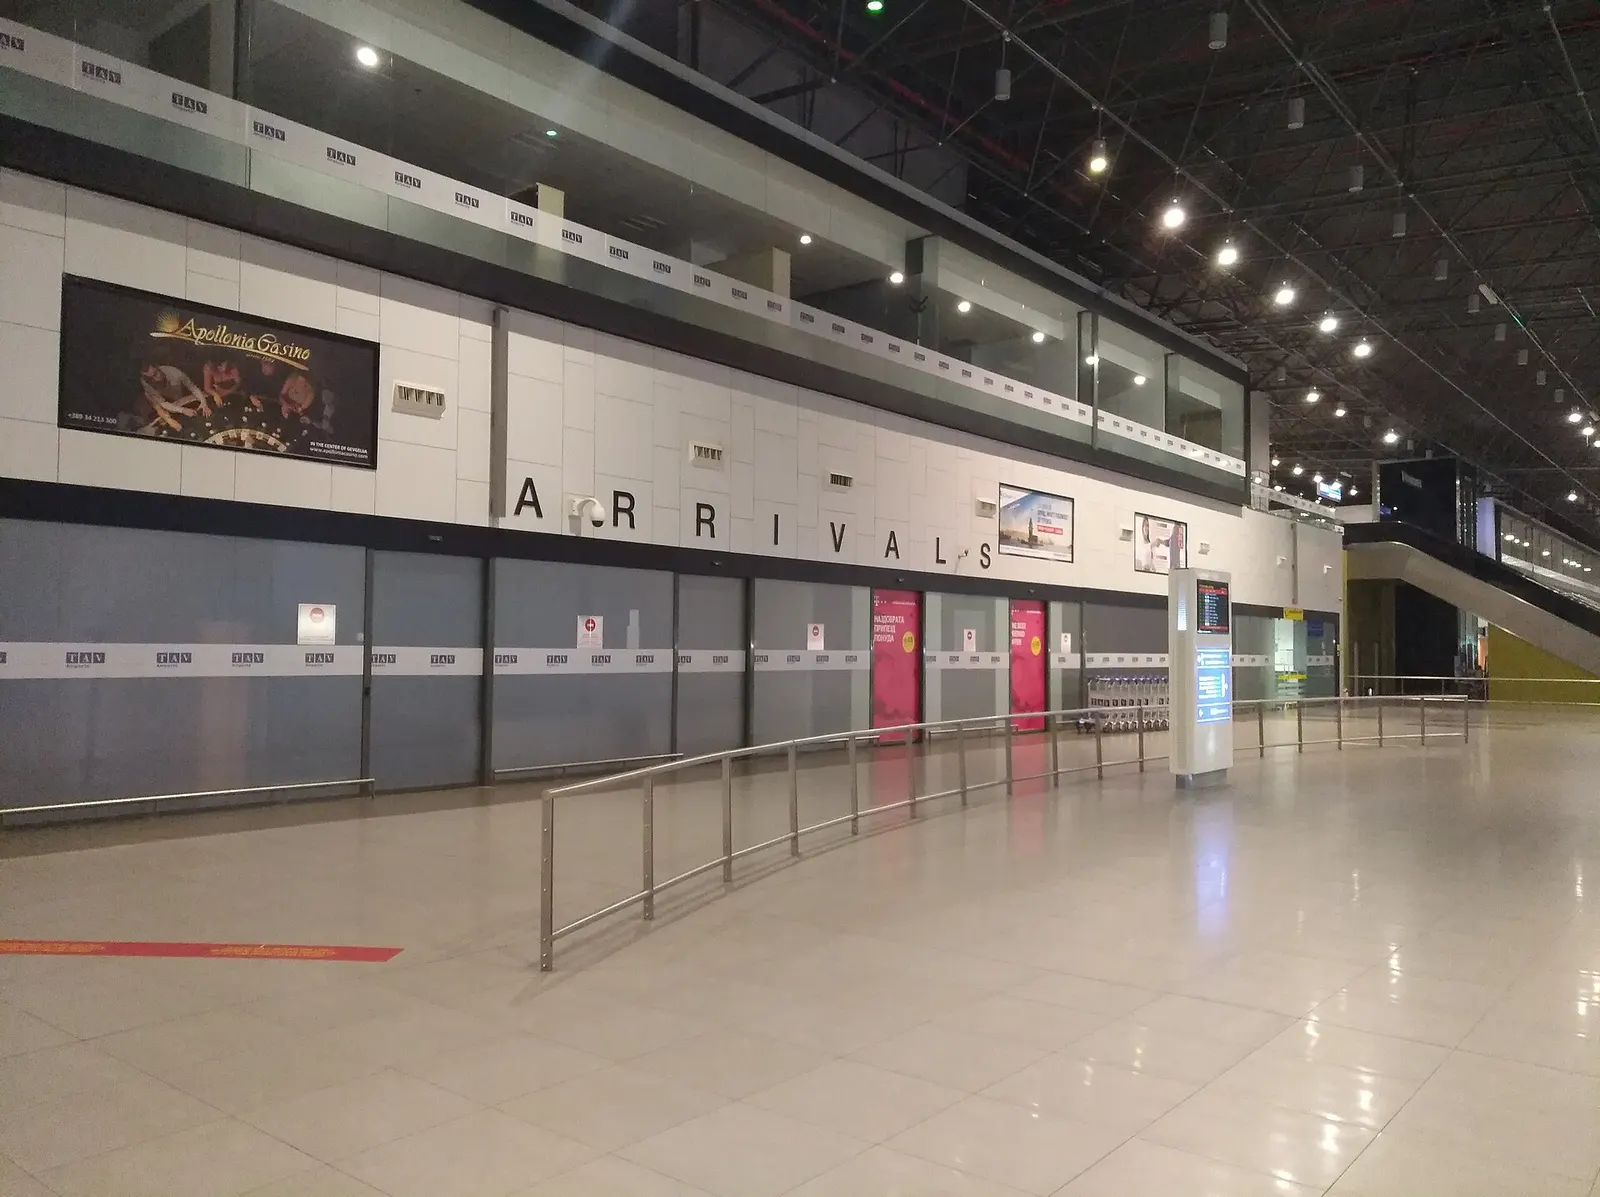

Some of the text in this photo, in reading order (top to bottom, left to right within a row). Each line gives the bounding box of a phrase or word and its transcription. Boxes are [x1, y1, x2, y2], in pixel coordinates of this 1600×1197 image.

[0, 33, 24, 51] AV
[82, 60, 121, 84] TAV
[172, 93, 207, 114] TAV
[254, 121, 285, 141] TAV
[327, 147, 356, 166] TAV
[395, 172, 421, 189] TAV
[455, 193, 479, 208] TAV
[511, 212, 533, 227] TAV
[562, 229, 582, 243] TAV
[610, 246, 629, 260] TAV
[177, 318, 310, 360] Apollonia Casino
[513, 477, 991, 569] ARRIVALS
[66, 652, 105, 663] TAV
[157, 653, 191, 663] TAV
[232, 653, 264, 663] TAV
[305, 653, 334, 663] TAV
[372, 654, 396, 663] TAV
[431, 655, 455, 664] TAV
[495, 655, 517, 663] TAV
[547, 655, 567, 663] TAV
